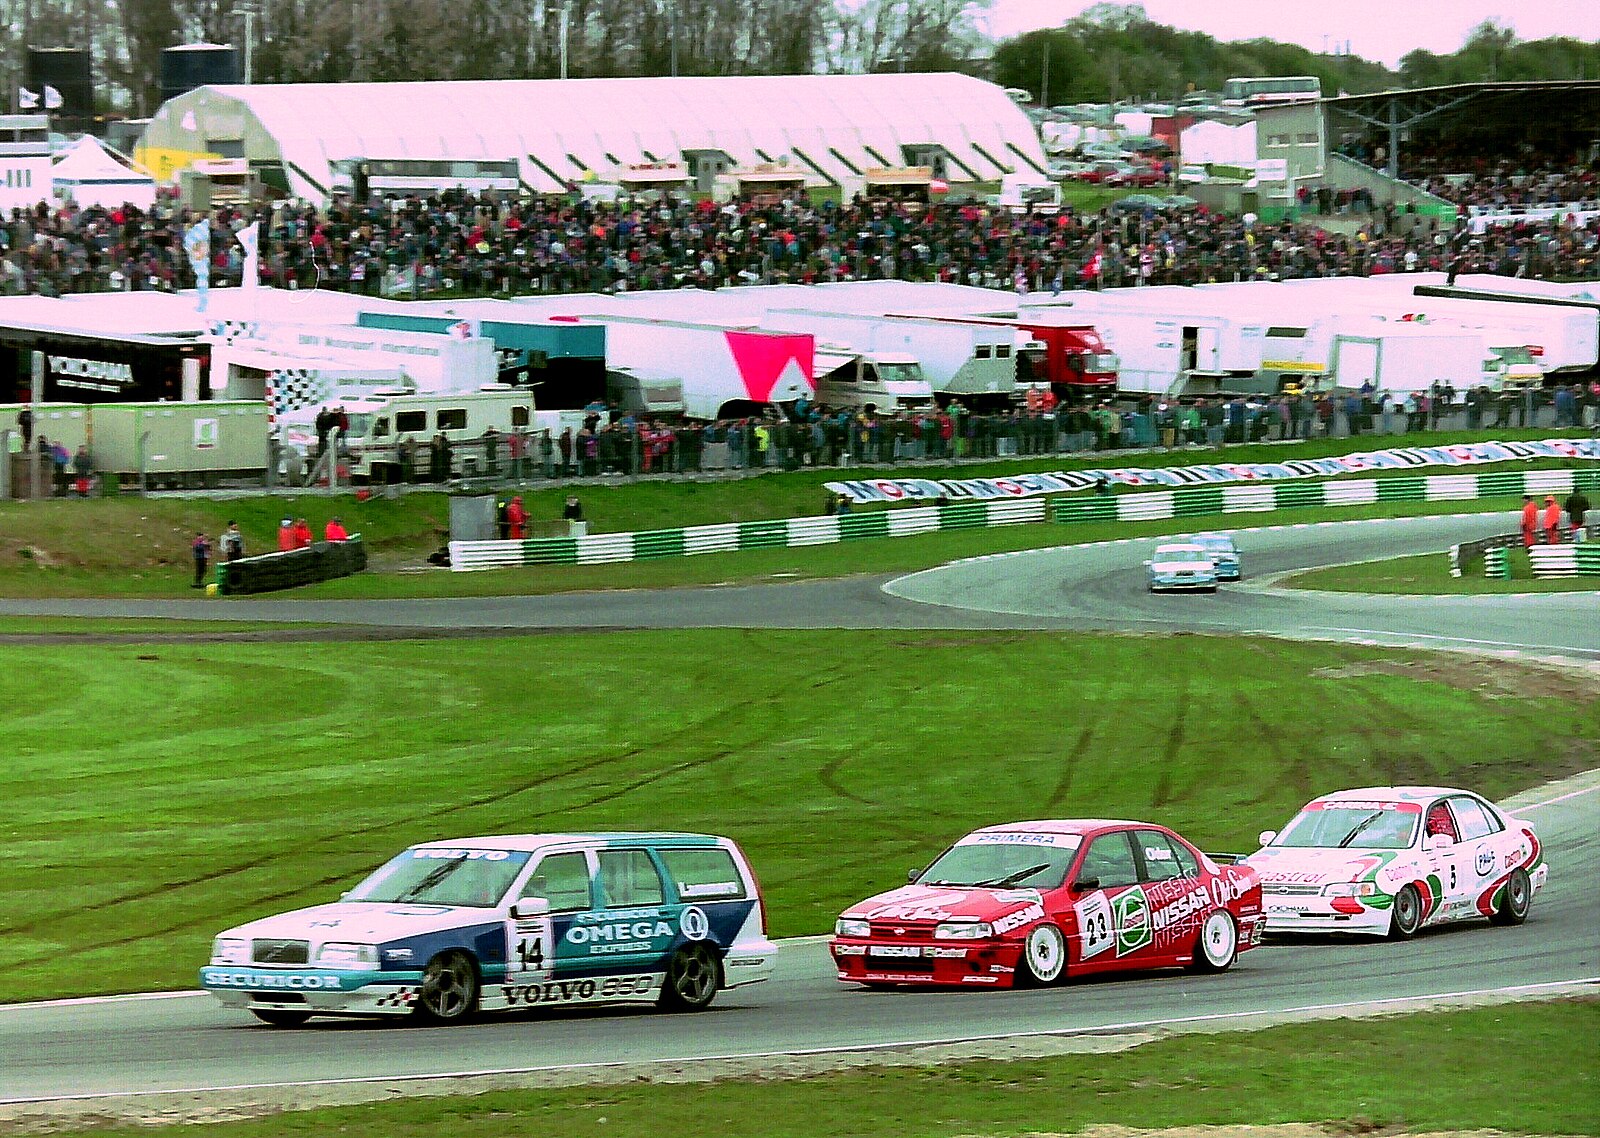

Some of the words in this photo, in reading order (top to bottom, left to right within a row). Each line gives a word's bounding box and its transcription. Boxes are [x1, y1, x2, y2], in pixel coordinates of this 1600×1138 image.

[978, 834, 1057, 845] PRIMERA
[1450, 864, 1457, 890] 5
[991, 903, 1046, 935] NISSAN
[1152, 885, 1212, 931] NISSAN
[566, 921, 674, 944] OMEGA
[1086, 912, 1107, 947] 23
[515, 937, 545, 971] 14
[590, 941, 652, 954] EXPRESS
[205, 971, 342, 989] SECURICOR
[501, 980, 596, 1005] VOLVO
[601, 975, 654, 997] 850
